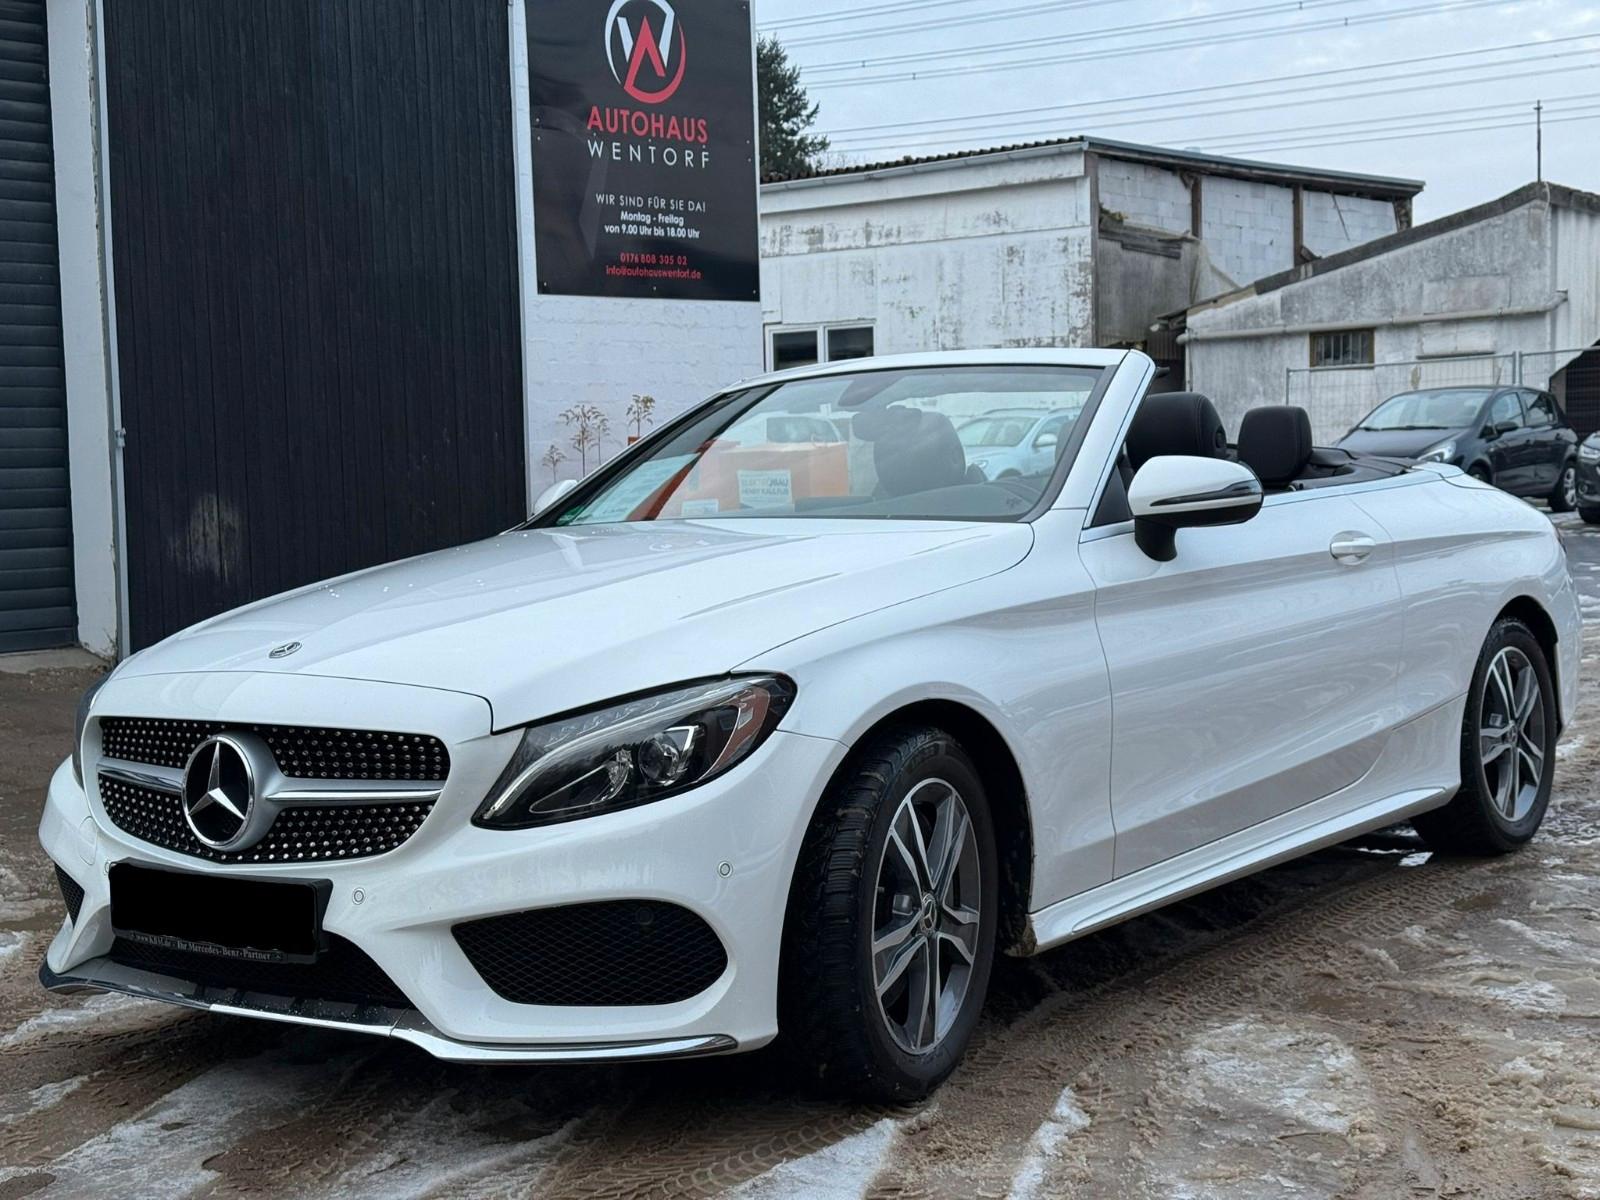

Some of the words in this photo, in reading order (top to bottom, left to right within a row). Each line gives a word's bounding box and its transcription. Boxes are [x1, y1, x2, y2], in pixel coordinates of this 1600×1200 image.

[587, 106, 707, 142] AUTOHAUS
[587, 139, 710, 169] WENTORF
[595, 193, 615, 205] WIR
[619, 195, 644, 207] SIND
[647, 196, 666, 209] FÜR
[670, 199, 684, 210] SIE
[688, 200, 706, 213] DA!
[620, 210, 651, 224] Montag
[658, 213, 684, 227] Freitag
[604, 224, 620, 234] von
[621, 224, 638, 235] 9.00
[639, 226, 652, 236] Uhr
[653, 227, 665, 237] bis
[666, 227, 687, 238] 18.00
[687, 229, 700, 239] Uhr
[620, 252, 639, 263] 0176
[659, 255, 674, 265] 305
[677, 256, 688, 265] 02
[606, 265, 702, 280] info@autohauswentorf.de
[177, 940, 188, 950] Ihr
